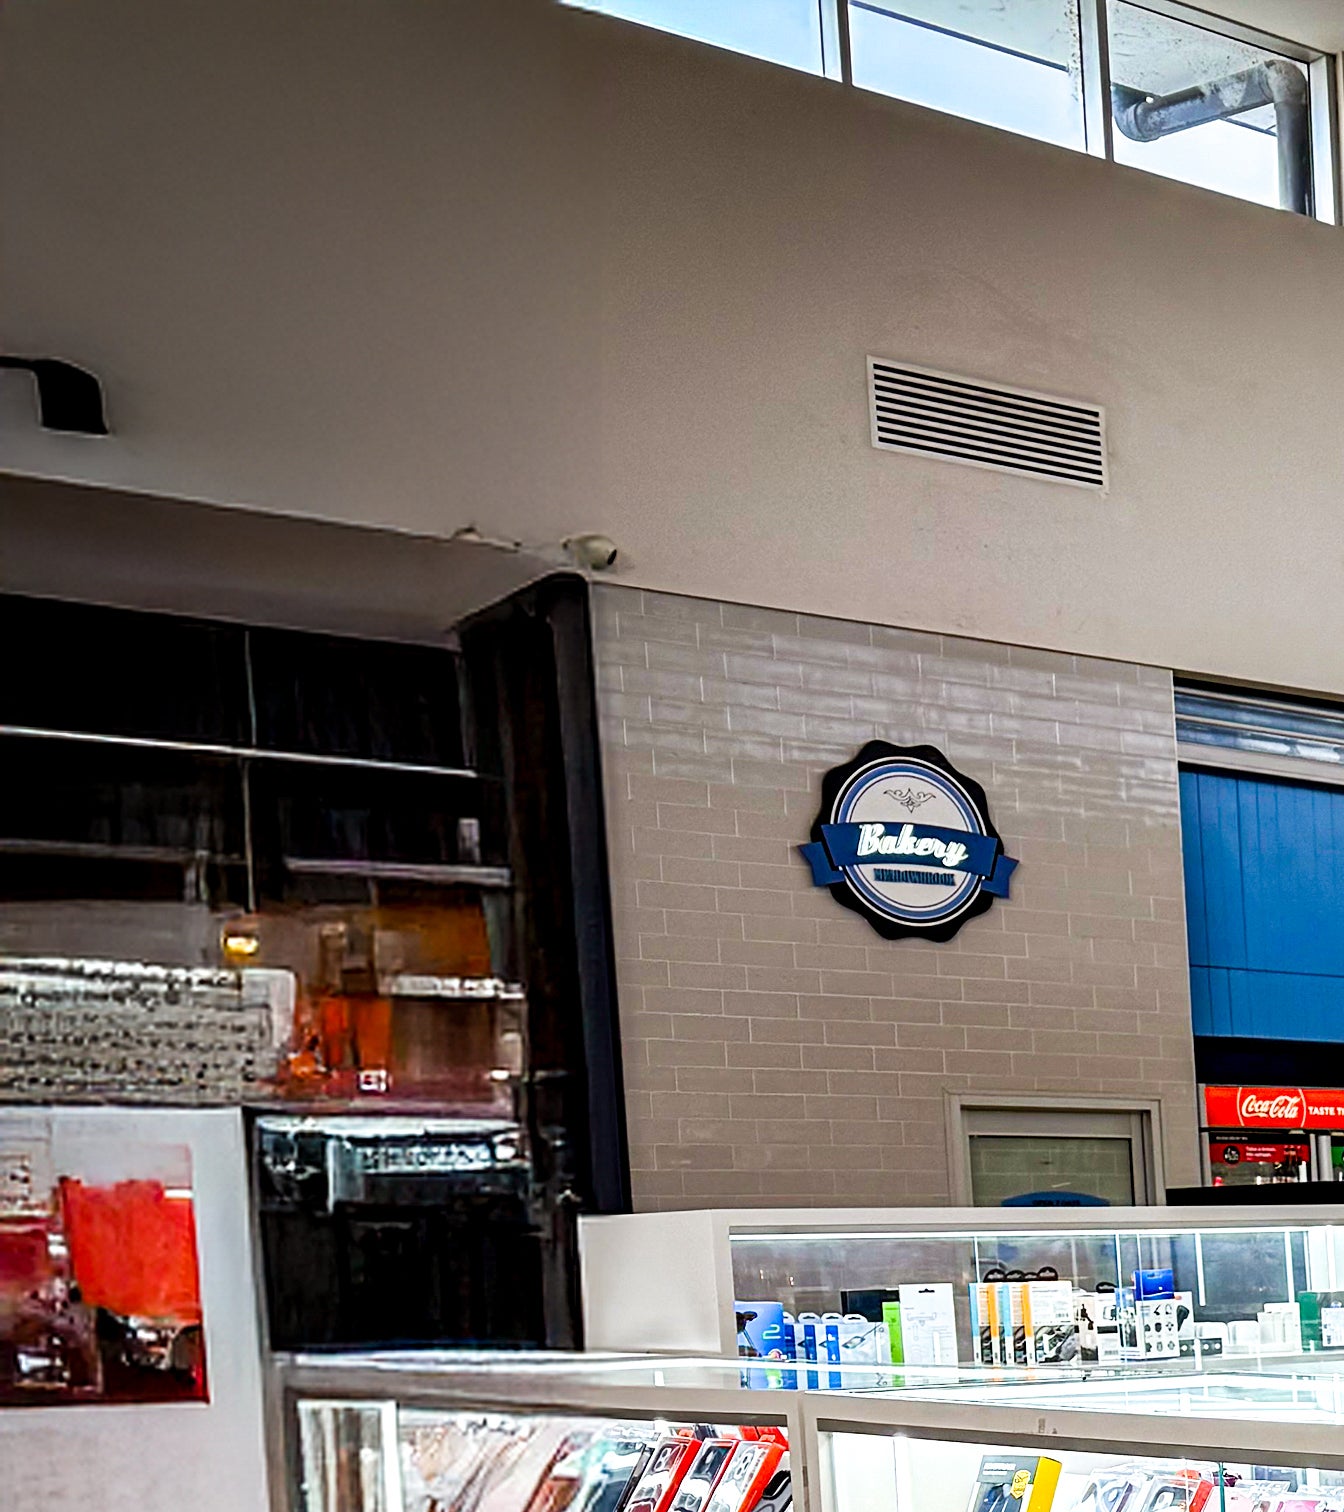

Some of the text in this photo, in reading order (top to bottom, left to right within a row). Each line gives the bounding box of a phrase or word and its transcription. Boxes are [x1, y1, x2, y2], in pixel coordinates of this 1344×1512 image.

[857, 823, 970, 867] Bakery
[1241, 1094, 1299, 1119] Coca-Cola
[1308, 1106, 1335, 1116] TASTE
